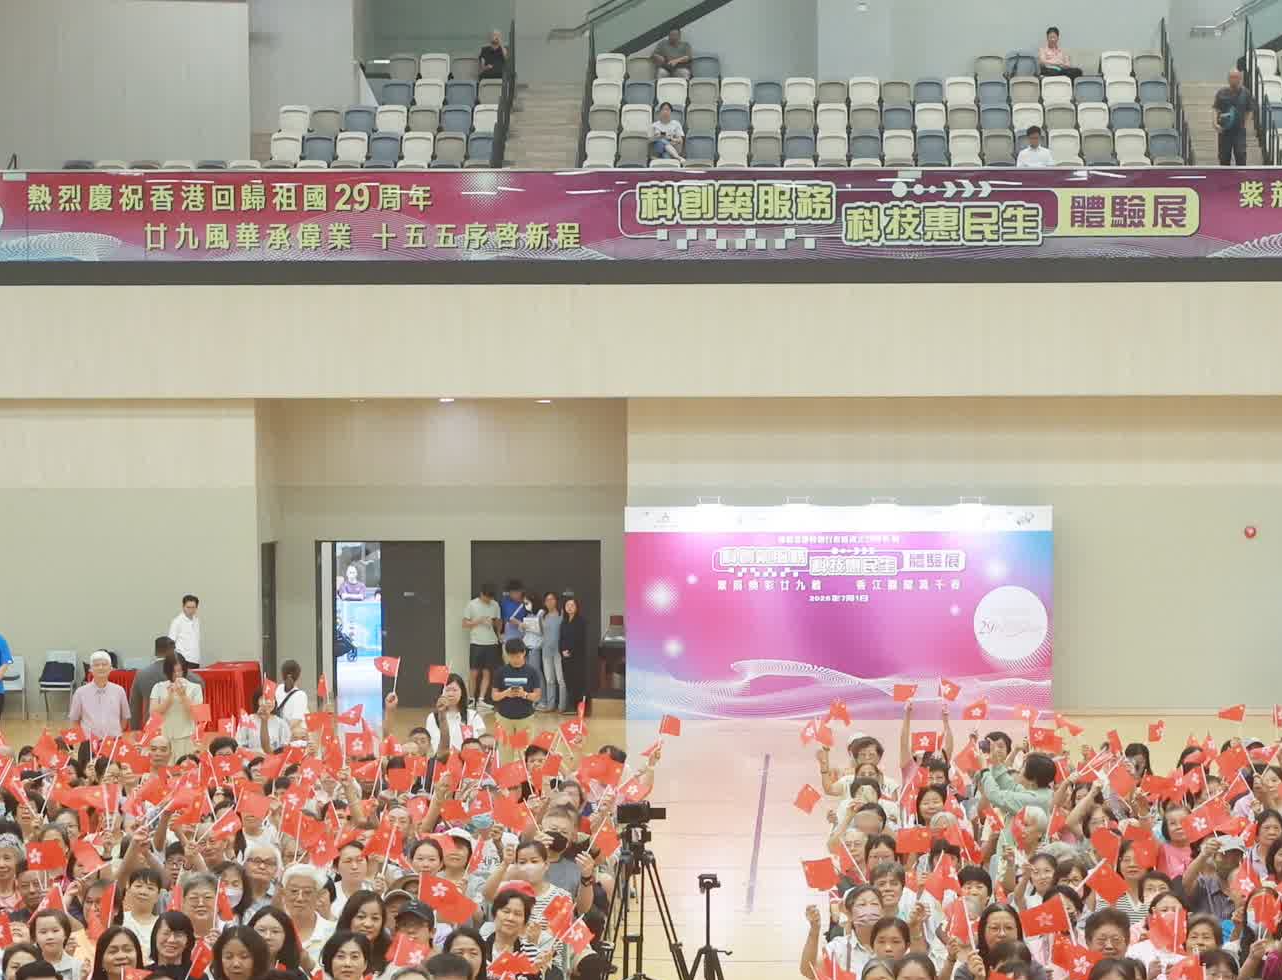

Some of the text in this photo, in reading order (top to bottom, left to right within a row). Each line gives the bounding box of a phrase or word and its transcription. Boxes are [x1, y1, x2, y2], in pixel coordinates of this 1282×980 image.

[637, 182, 836, 223] 科創築服務
[1070, 195, 1188, 230] 體驗展
[144, 222, 352, 251] 廿九風華承偉業
[843, 204, 1046, 245] 科技惠民生
